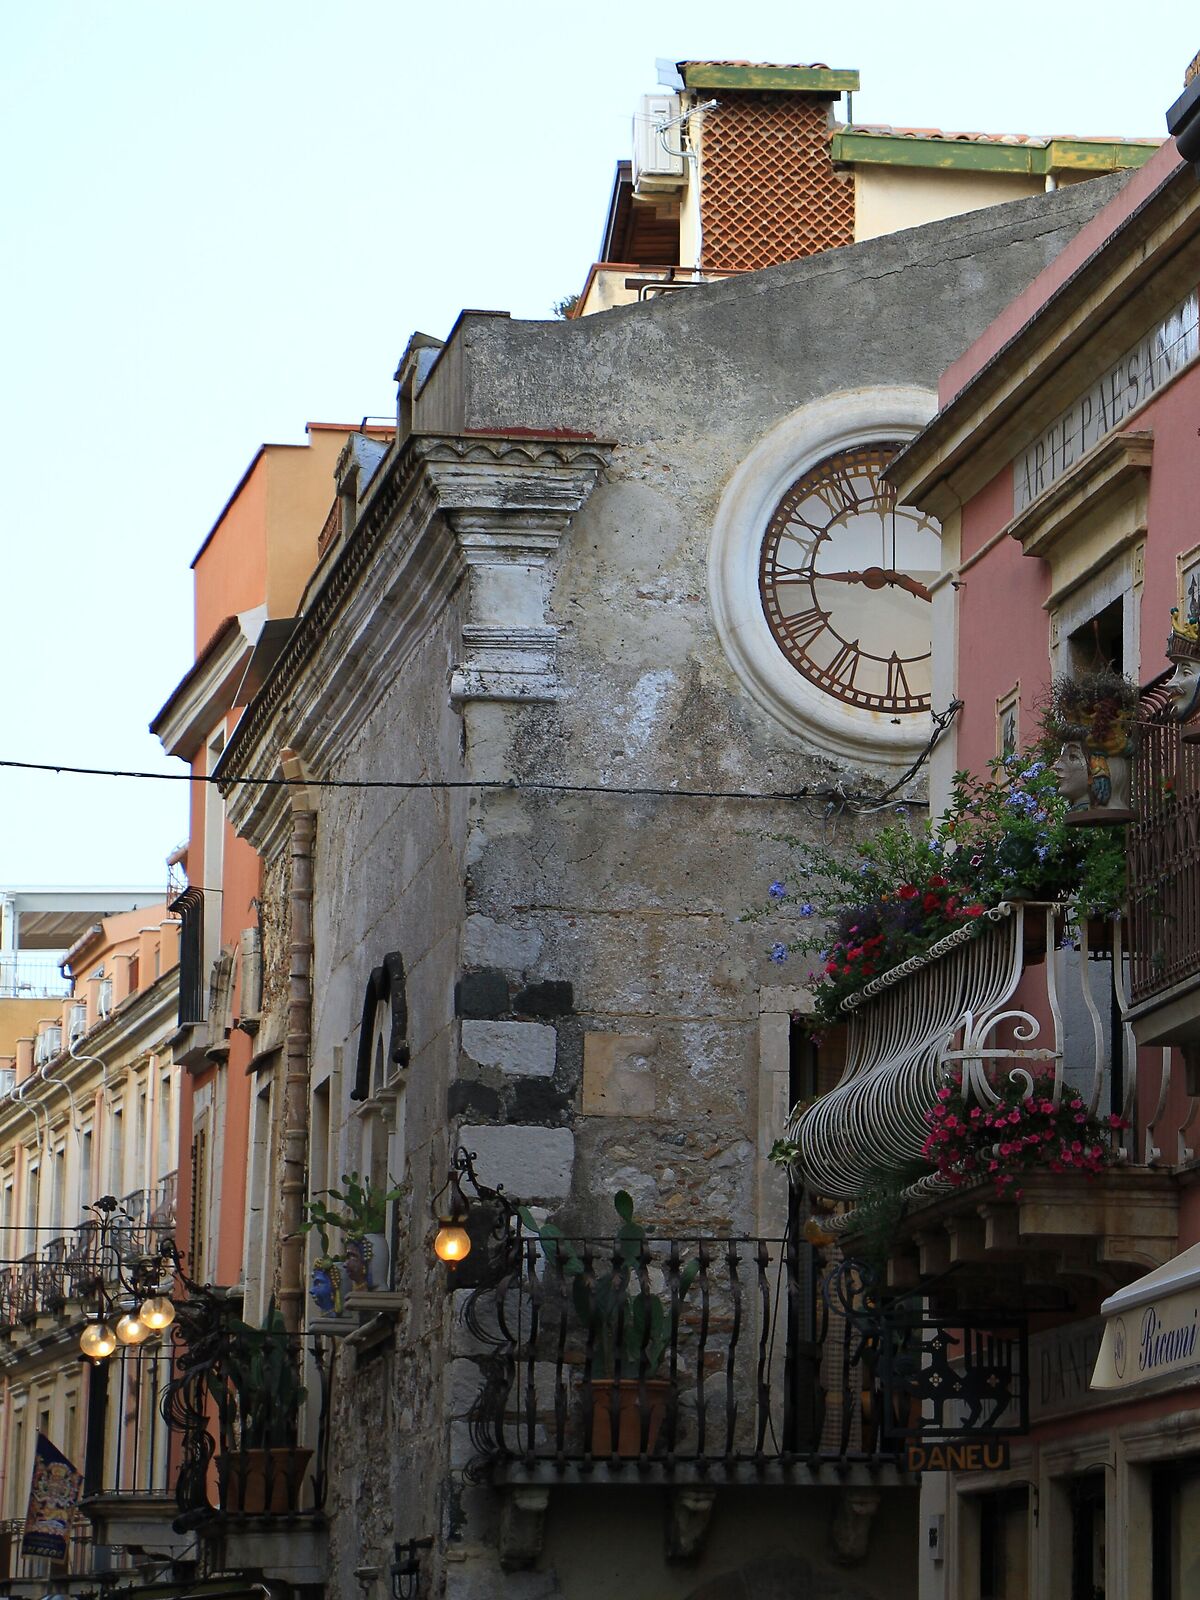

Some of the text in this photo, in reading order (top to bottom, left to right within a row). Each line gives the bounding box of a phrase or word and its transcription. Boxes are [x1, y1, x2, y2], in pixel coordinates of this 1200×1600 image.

[1021, 413, 1074, 508] ARTE
[775, 563, 812, 584] IX
[782, 607, 826, 652] VIII
[826, 645, 860, 689] VII
[886, 661, 912, 697] VI
[1139, 1306, 1199, 1371] Ricami
[908, 1443, 1005, 1472] DANEU
